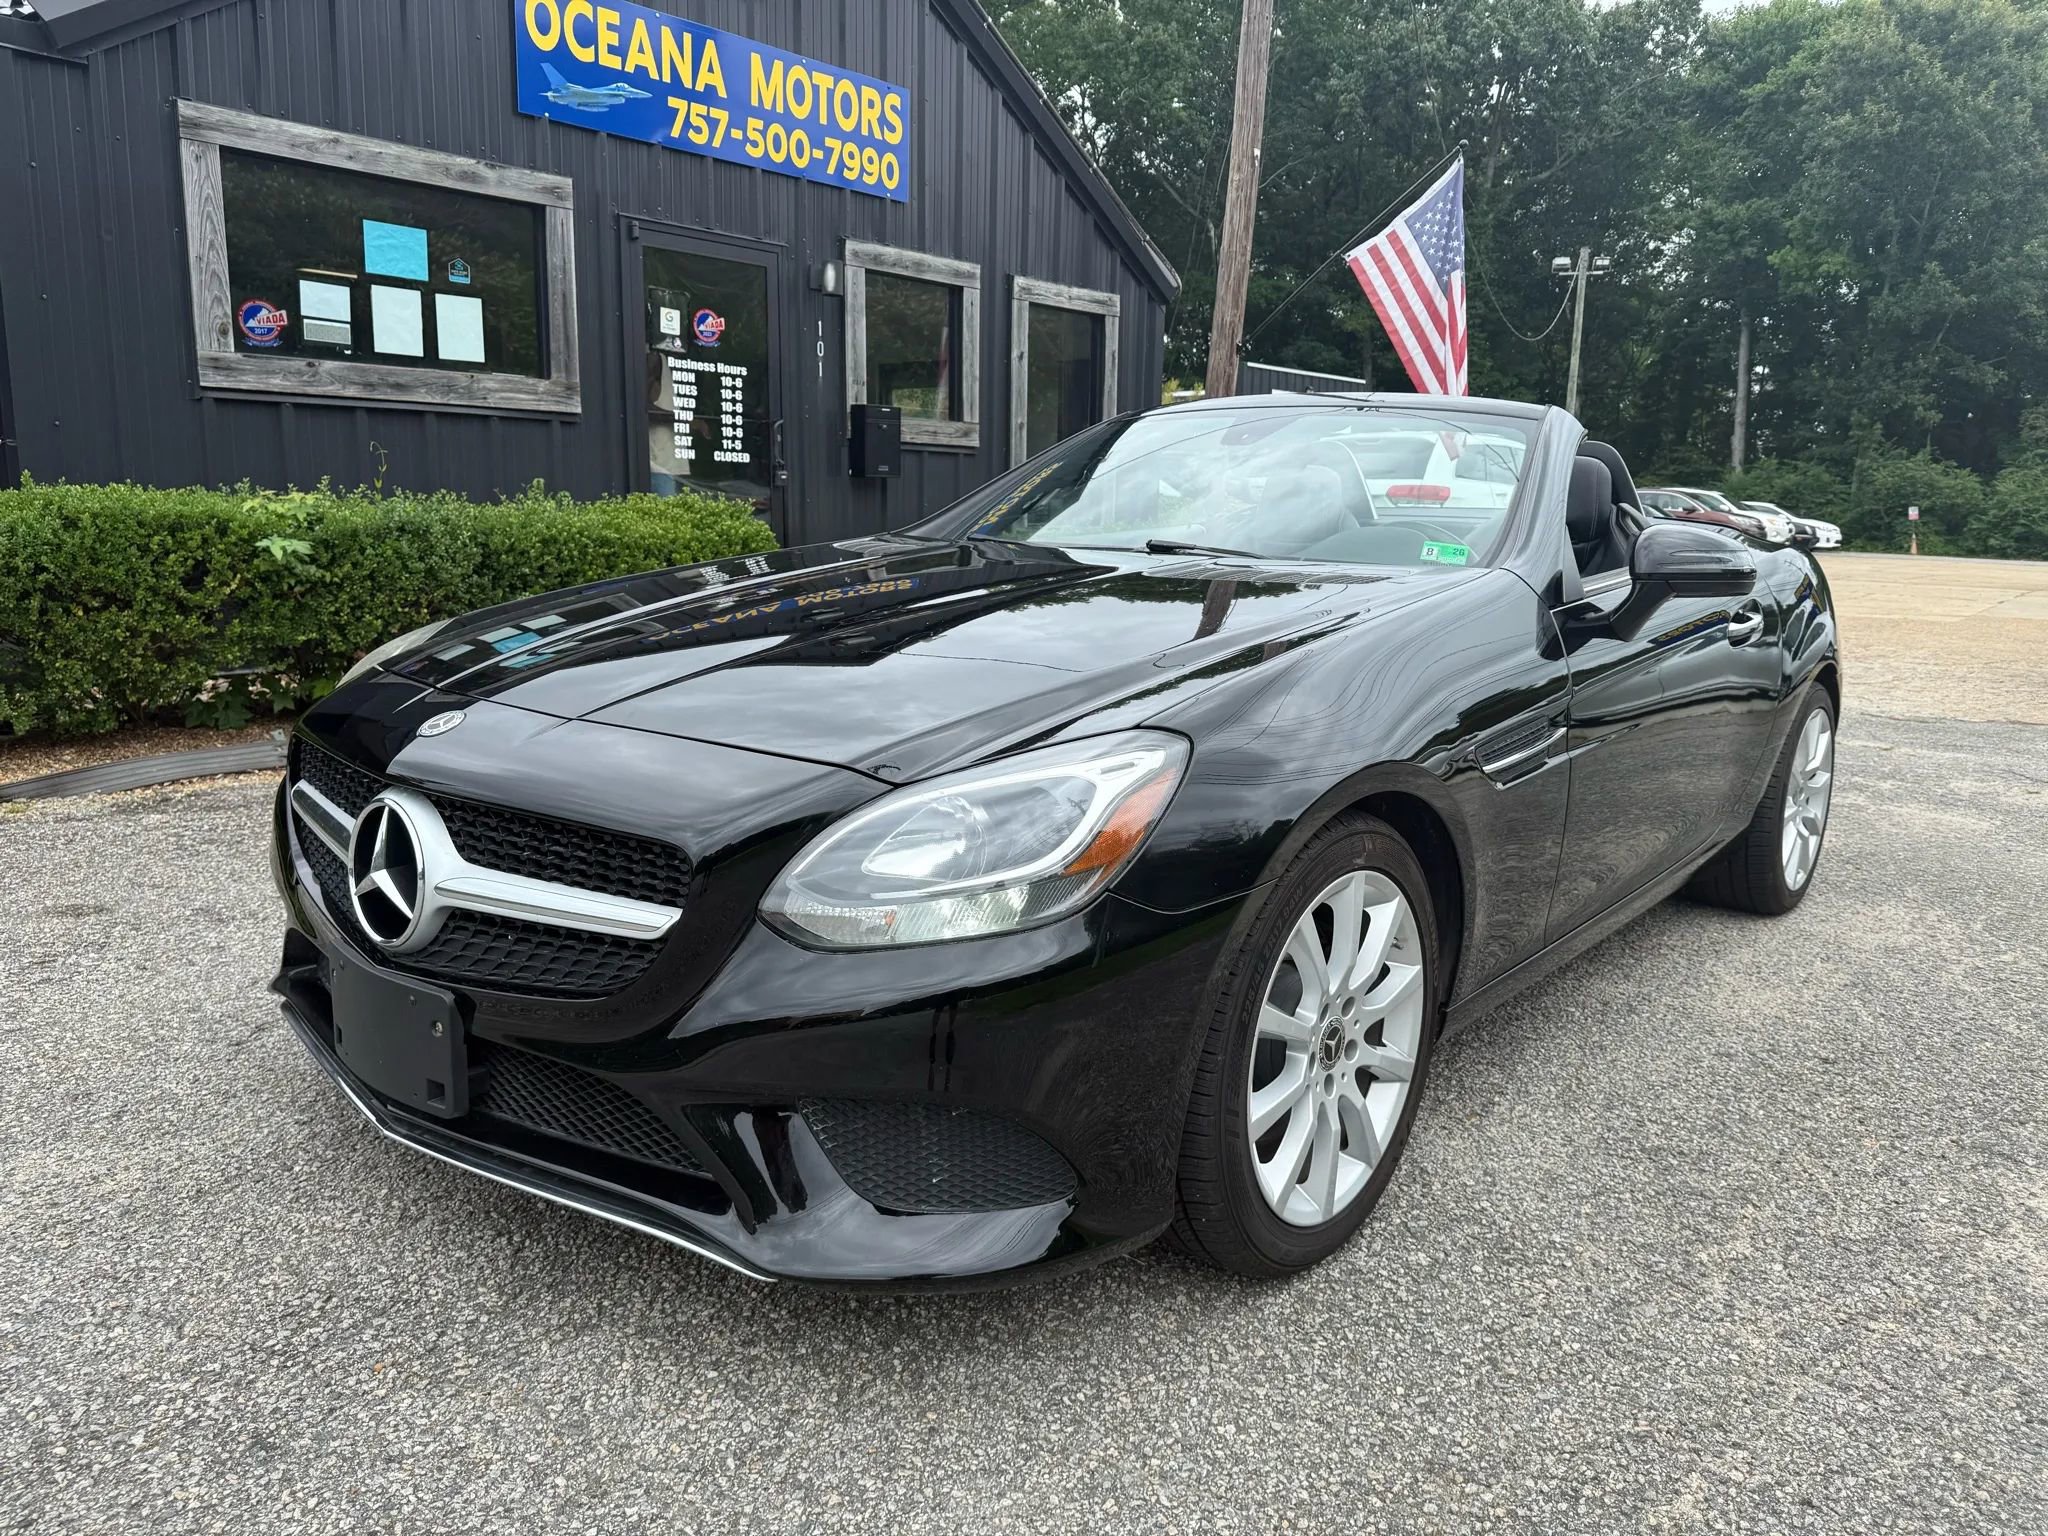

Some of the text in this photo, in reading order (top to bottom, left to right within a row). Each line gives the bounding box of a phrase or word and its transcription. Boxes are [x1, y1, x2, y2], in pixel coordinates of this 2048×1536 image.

[525, 0, 903, 145] OCEANA MOTORS
[667, 97, 900, 190] 757-500-7990
[257, 313, 285, 324] VIADA
[705, 319, 723, 330] VIADA
[667, 356, 747, 376] Business Hours
[672, 370, 743, 388] MON 10-6
[672, 384, 743, 401] TUES 10-6
[673, 396, 743, 413] WED 10-6
[673, 409, 743, 426] THU 10-6
[674, 422, 743, 438] FRI 10-6
[674, 435, 742, 450] SAT 11-5
[674, 448, 750, 463] SUN CLOSED
